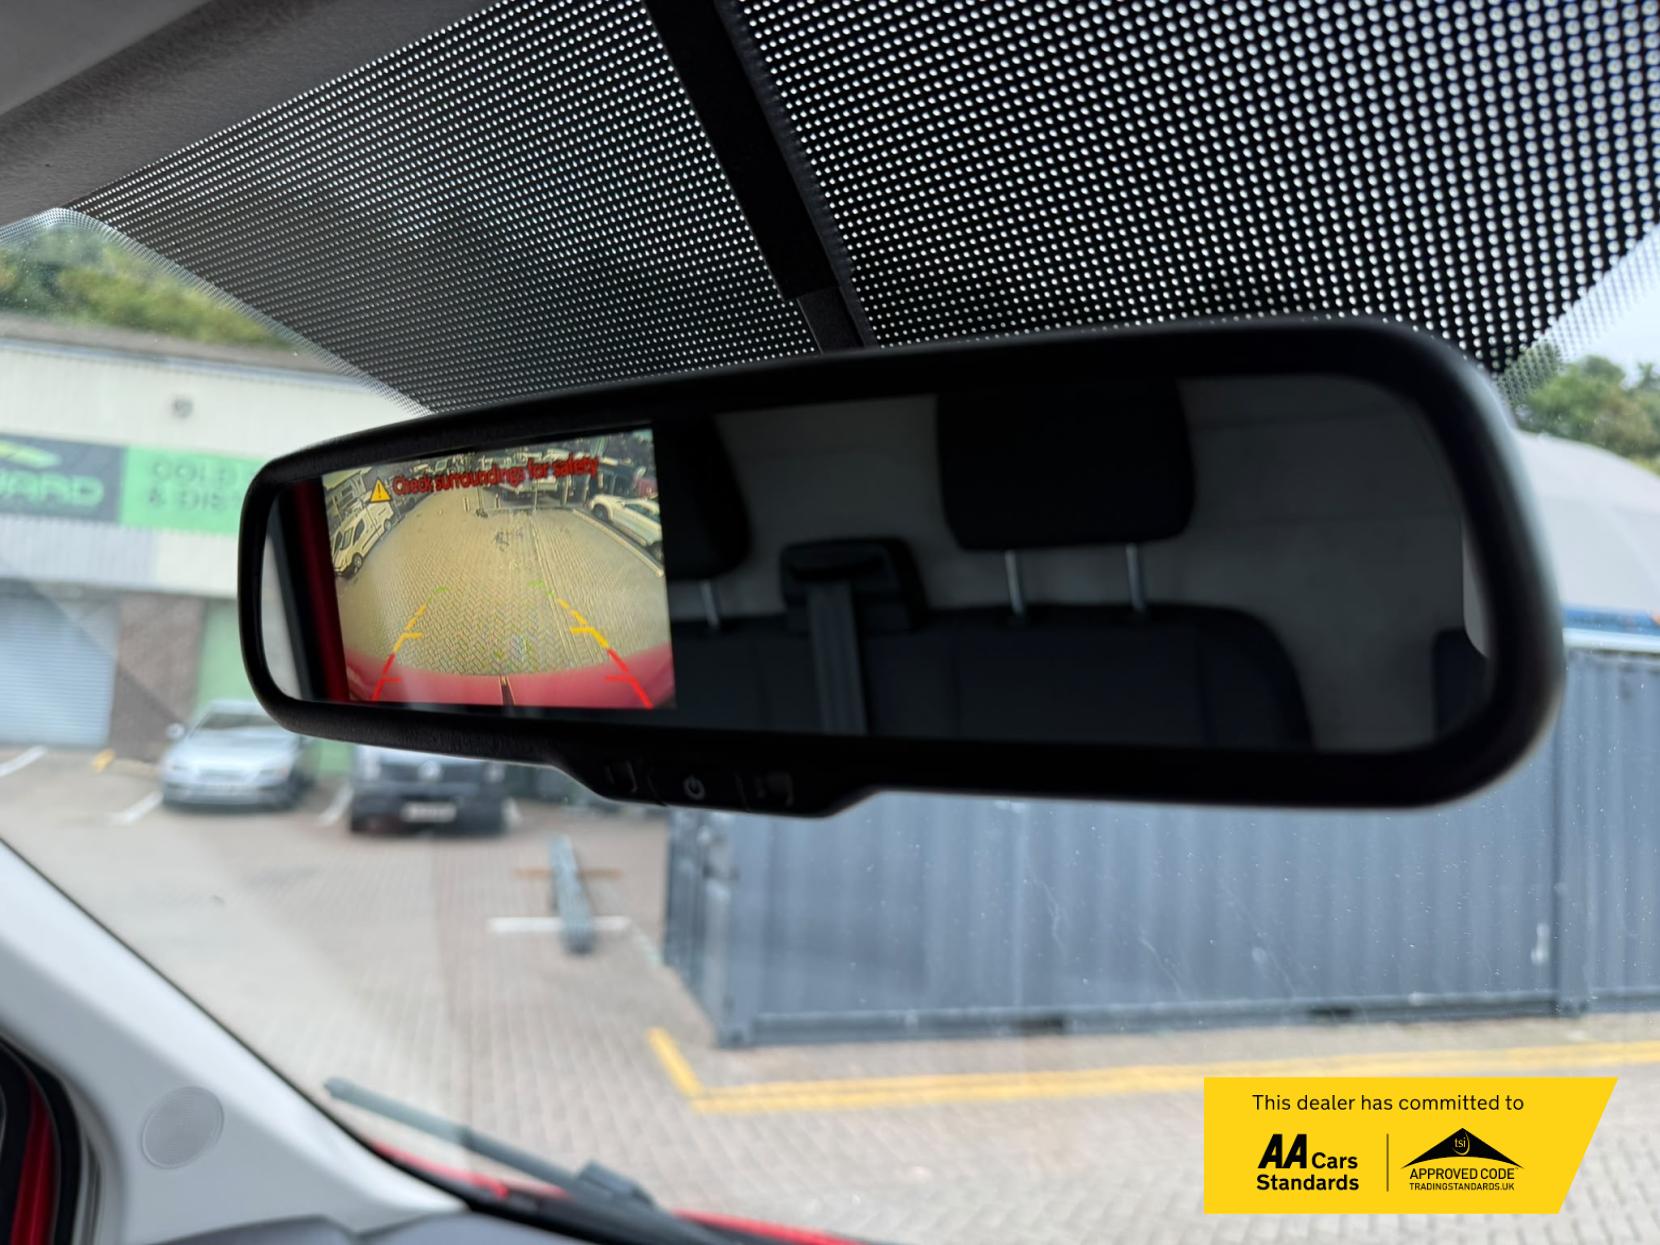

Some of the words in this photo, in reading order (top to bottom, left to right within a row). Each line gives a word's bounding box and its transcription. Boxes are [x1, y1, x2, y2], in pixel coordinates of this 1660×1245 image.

[392, 473, 434, 496] Check
[435, 463, 526, 492] surroundings
[527, 457, 549, 479] for
[551, 451, 598, 479] safety
